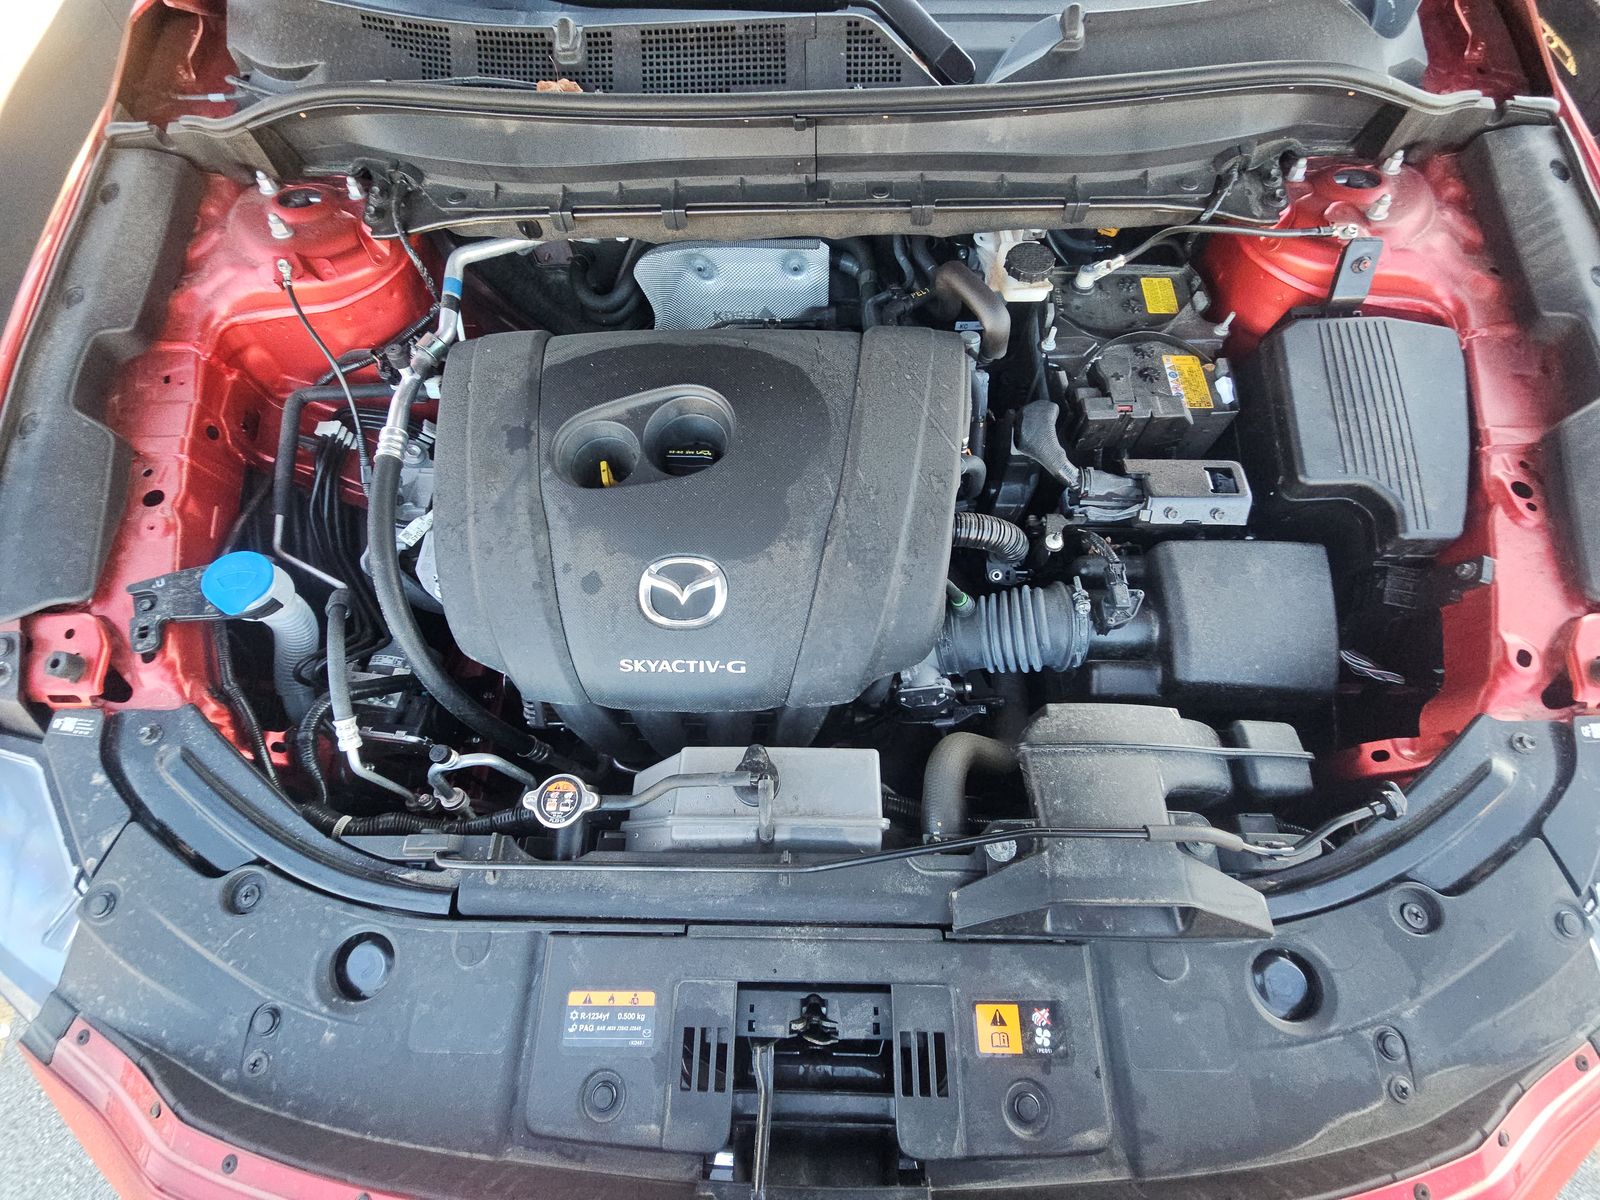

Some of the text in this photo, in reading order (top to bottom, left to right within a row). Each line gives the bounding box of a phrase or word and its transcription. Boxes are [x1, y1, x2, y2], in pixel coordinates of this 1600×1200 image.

[619, 659, 747, 674] SKYACTIV-G
[580, 1012, 646, 1022] R-1234yf 0.500 kg
[578, 1024, 594, 1032] PAG
